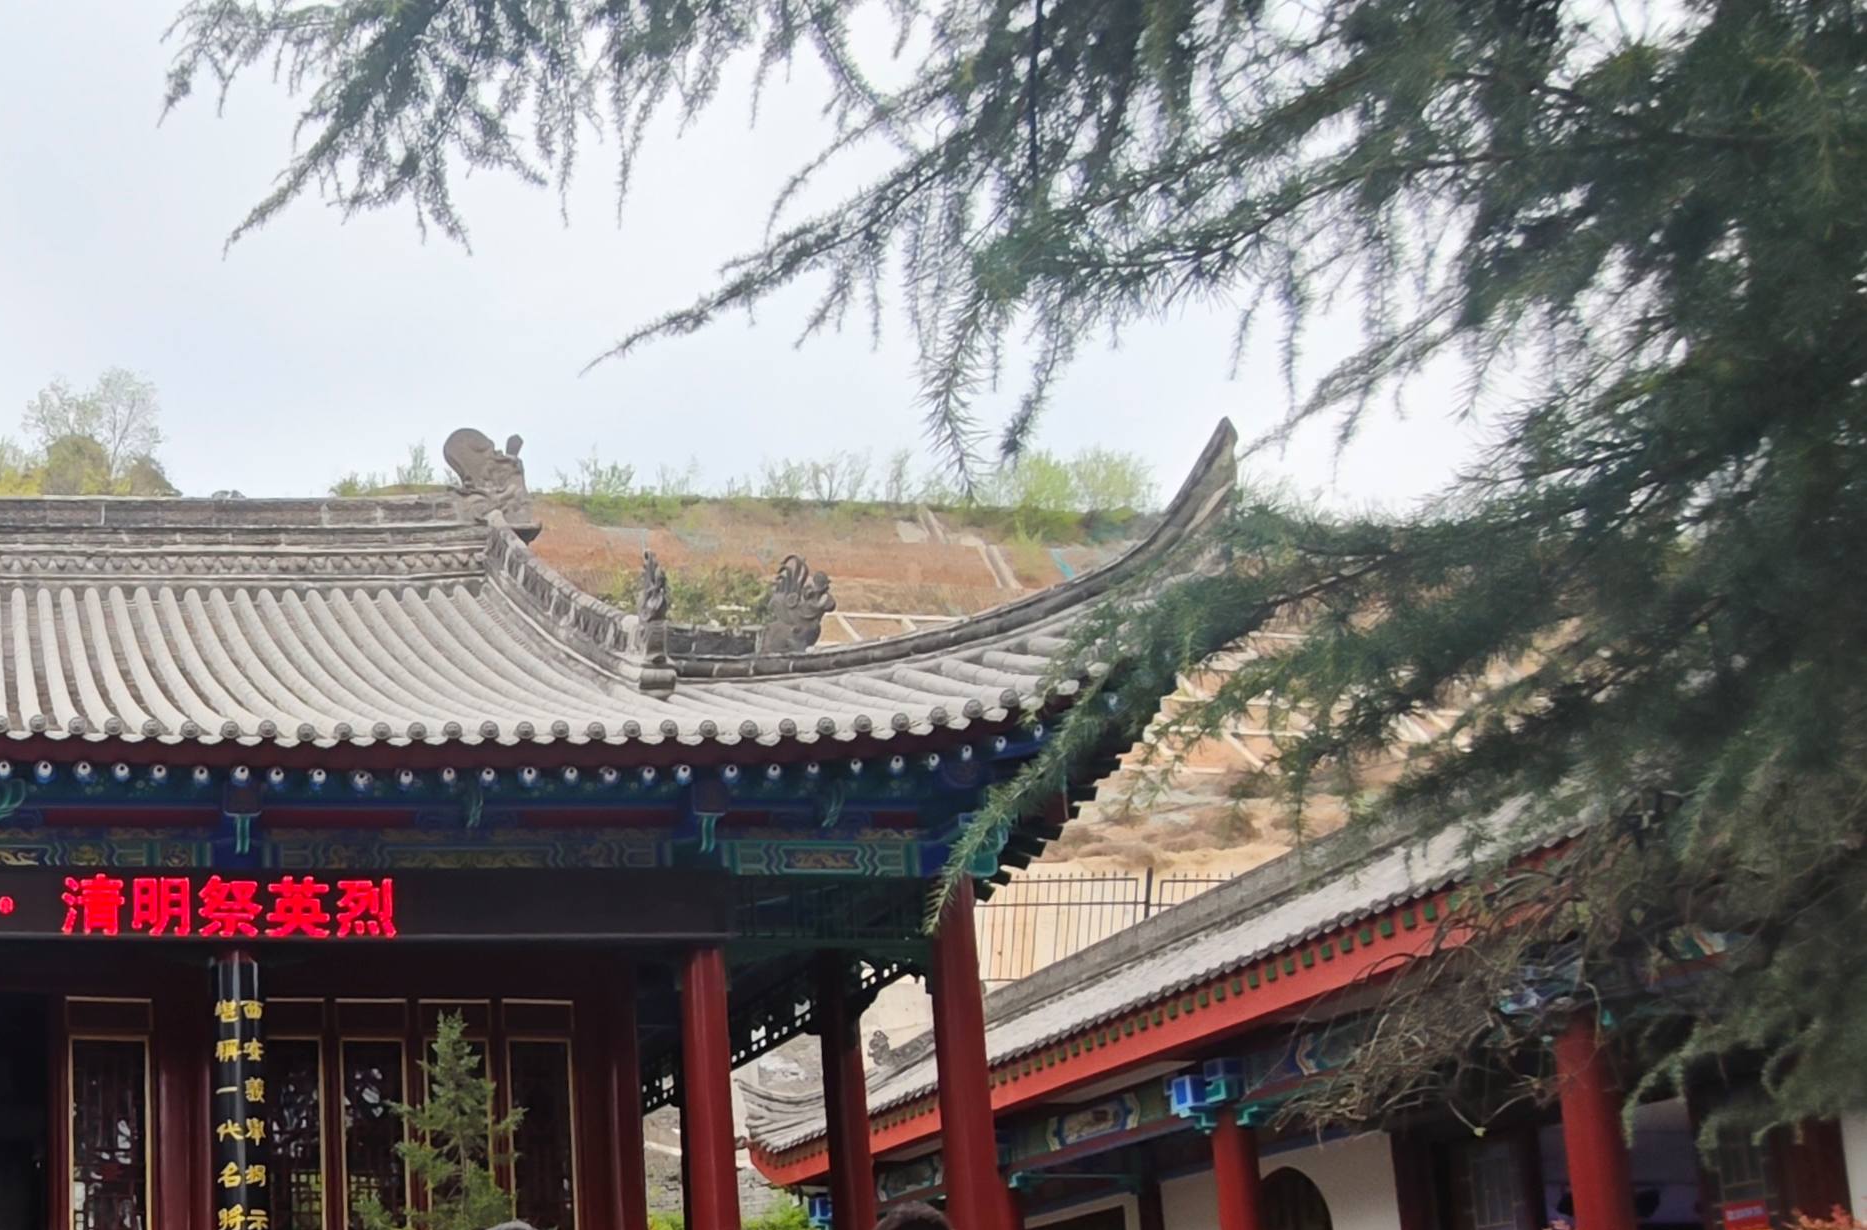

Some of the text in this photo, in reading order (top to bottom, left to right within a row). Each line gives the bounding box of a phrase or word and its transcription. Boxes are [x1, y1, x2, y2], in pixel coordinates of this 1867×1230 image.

[61, 873, 397, 938] 清明祭英烈
